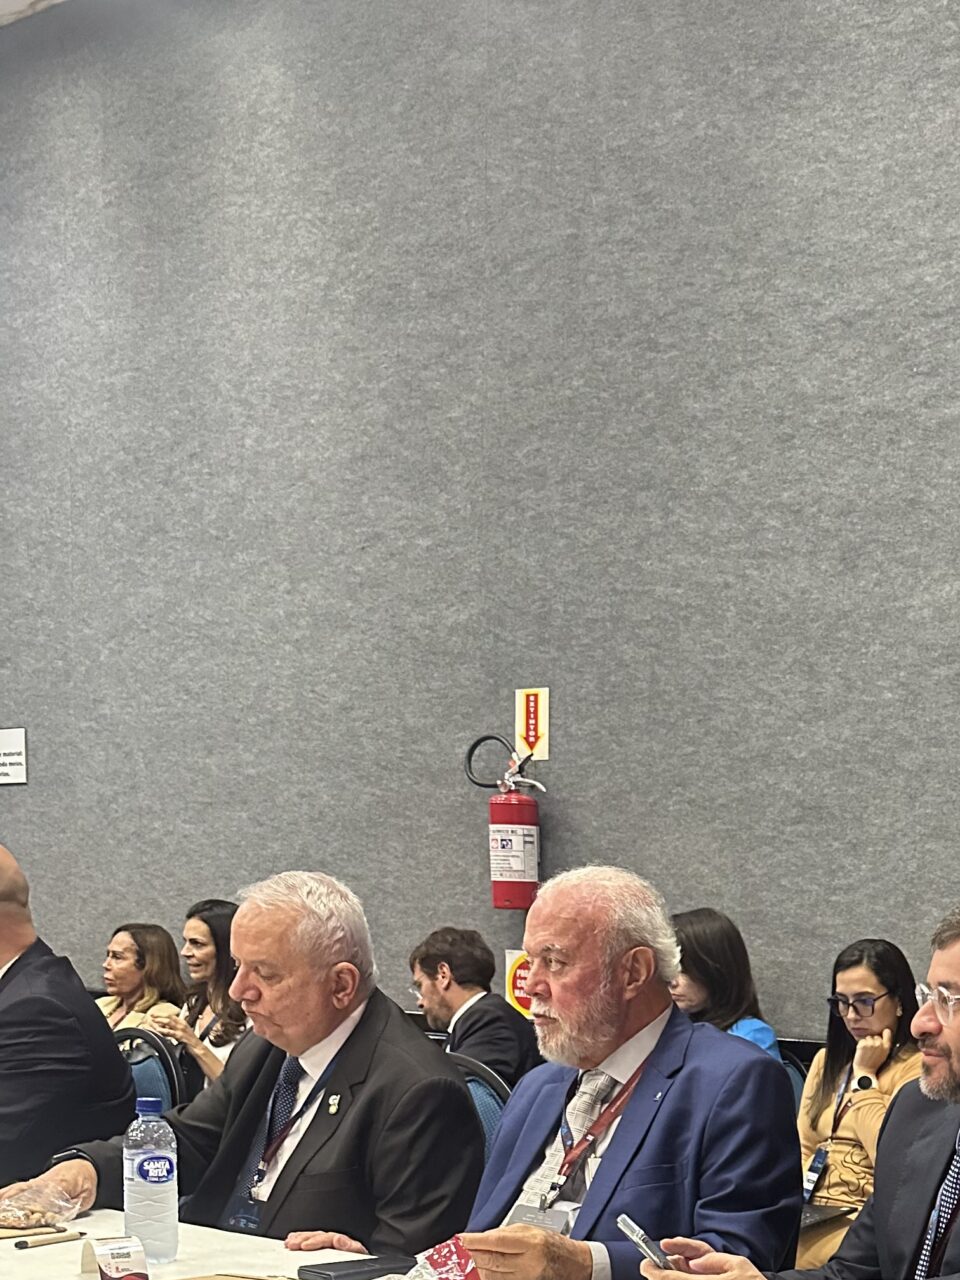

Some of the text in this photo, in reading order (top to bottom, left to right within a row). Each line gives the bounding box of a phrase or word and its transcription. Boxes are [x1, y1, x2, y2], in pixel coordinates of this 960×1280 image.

[528, 695, 536, 743] EXTINTOR
[143, 1161, 170, 1170] SANTA
[148, 1168, 168, 1177] RITA
